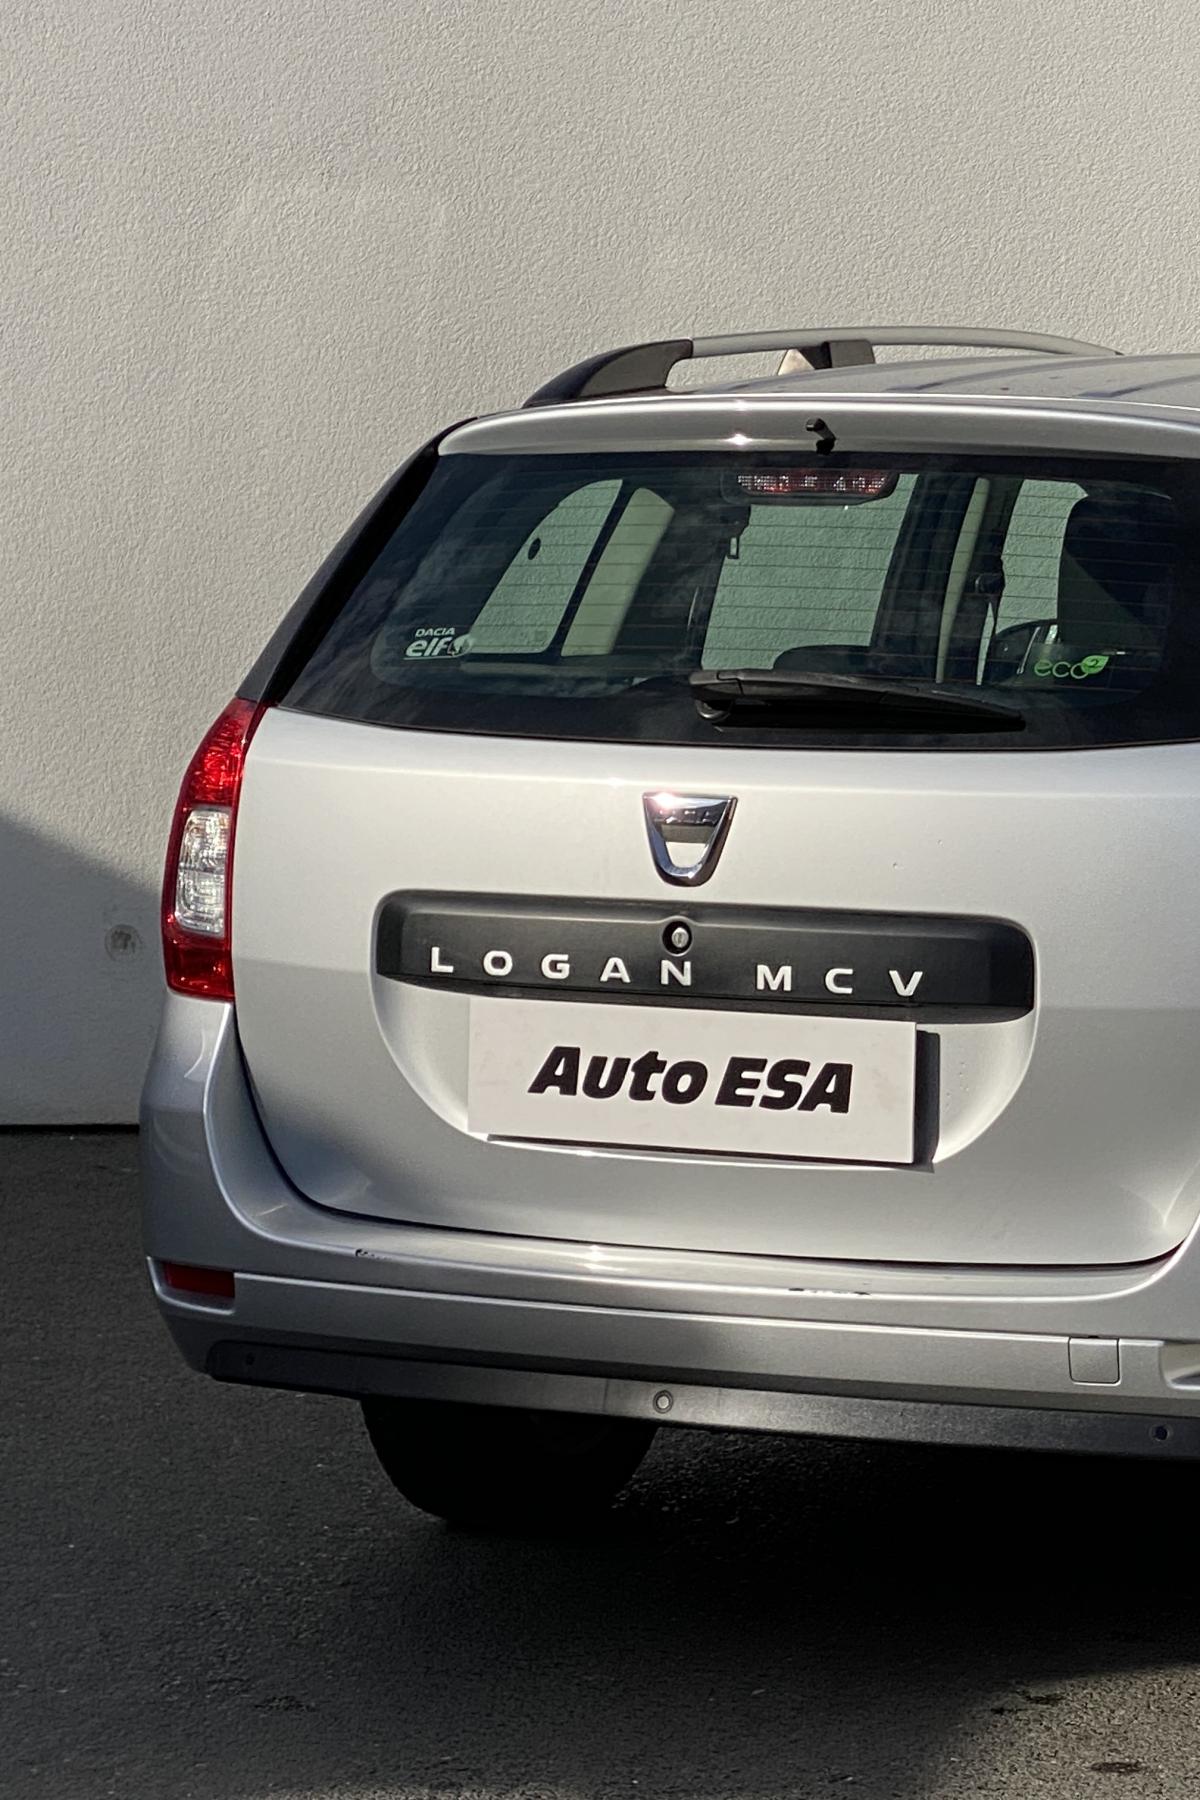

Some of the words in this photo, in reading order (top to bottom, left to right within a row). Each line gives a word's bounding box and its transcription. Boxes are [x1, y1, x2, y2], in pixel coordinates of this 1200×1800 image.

[415, 627, 455, 637] DACIA
[431, 946, 692, 987] LOGAN
[756, 964, 923, 997] MCV
[527, 1046, 708, 1103] Auto
[715, 1057, 853, 1114] ESA
